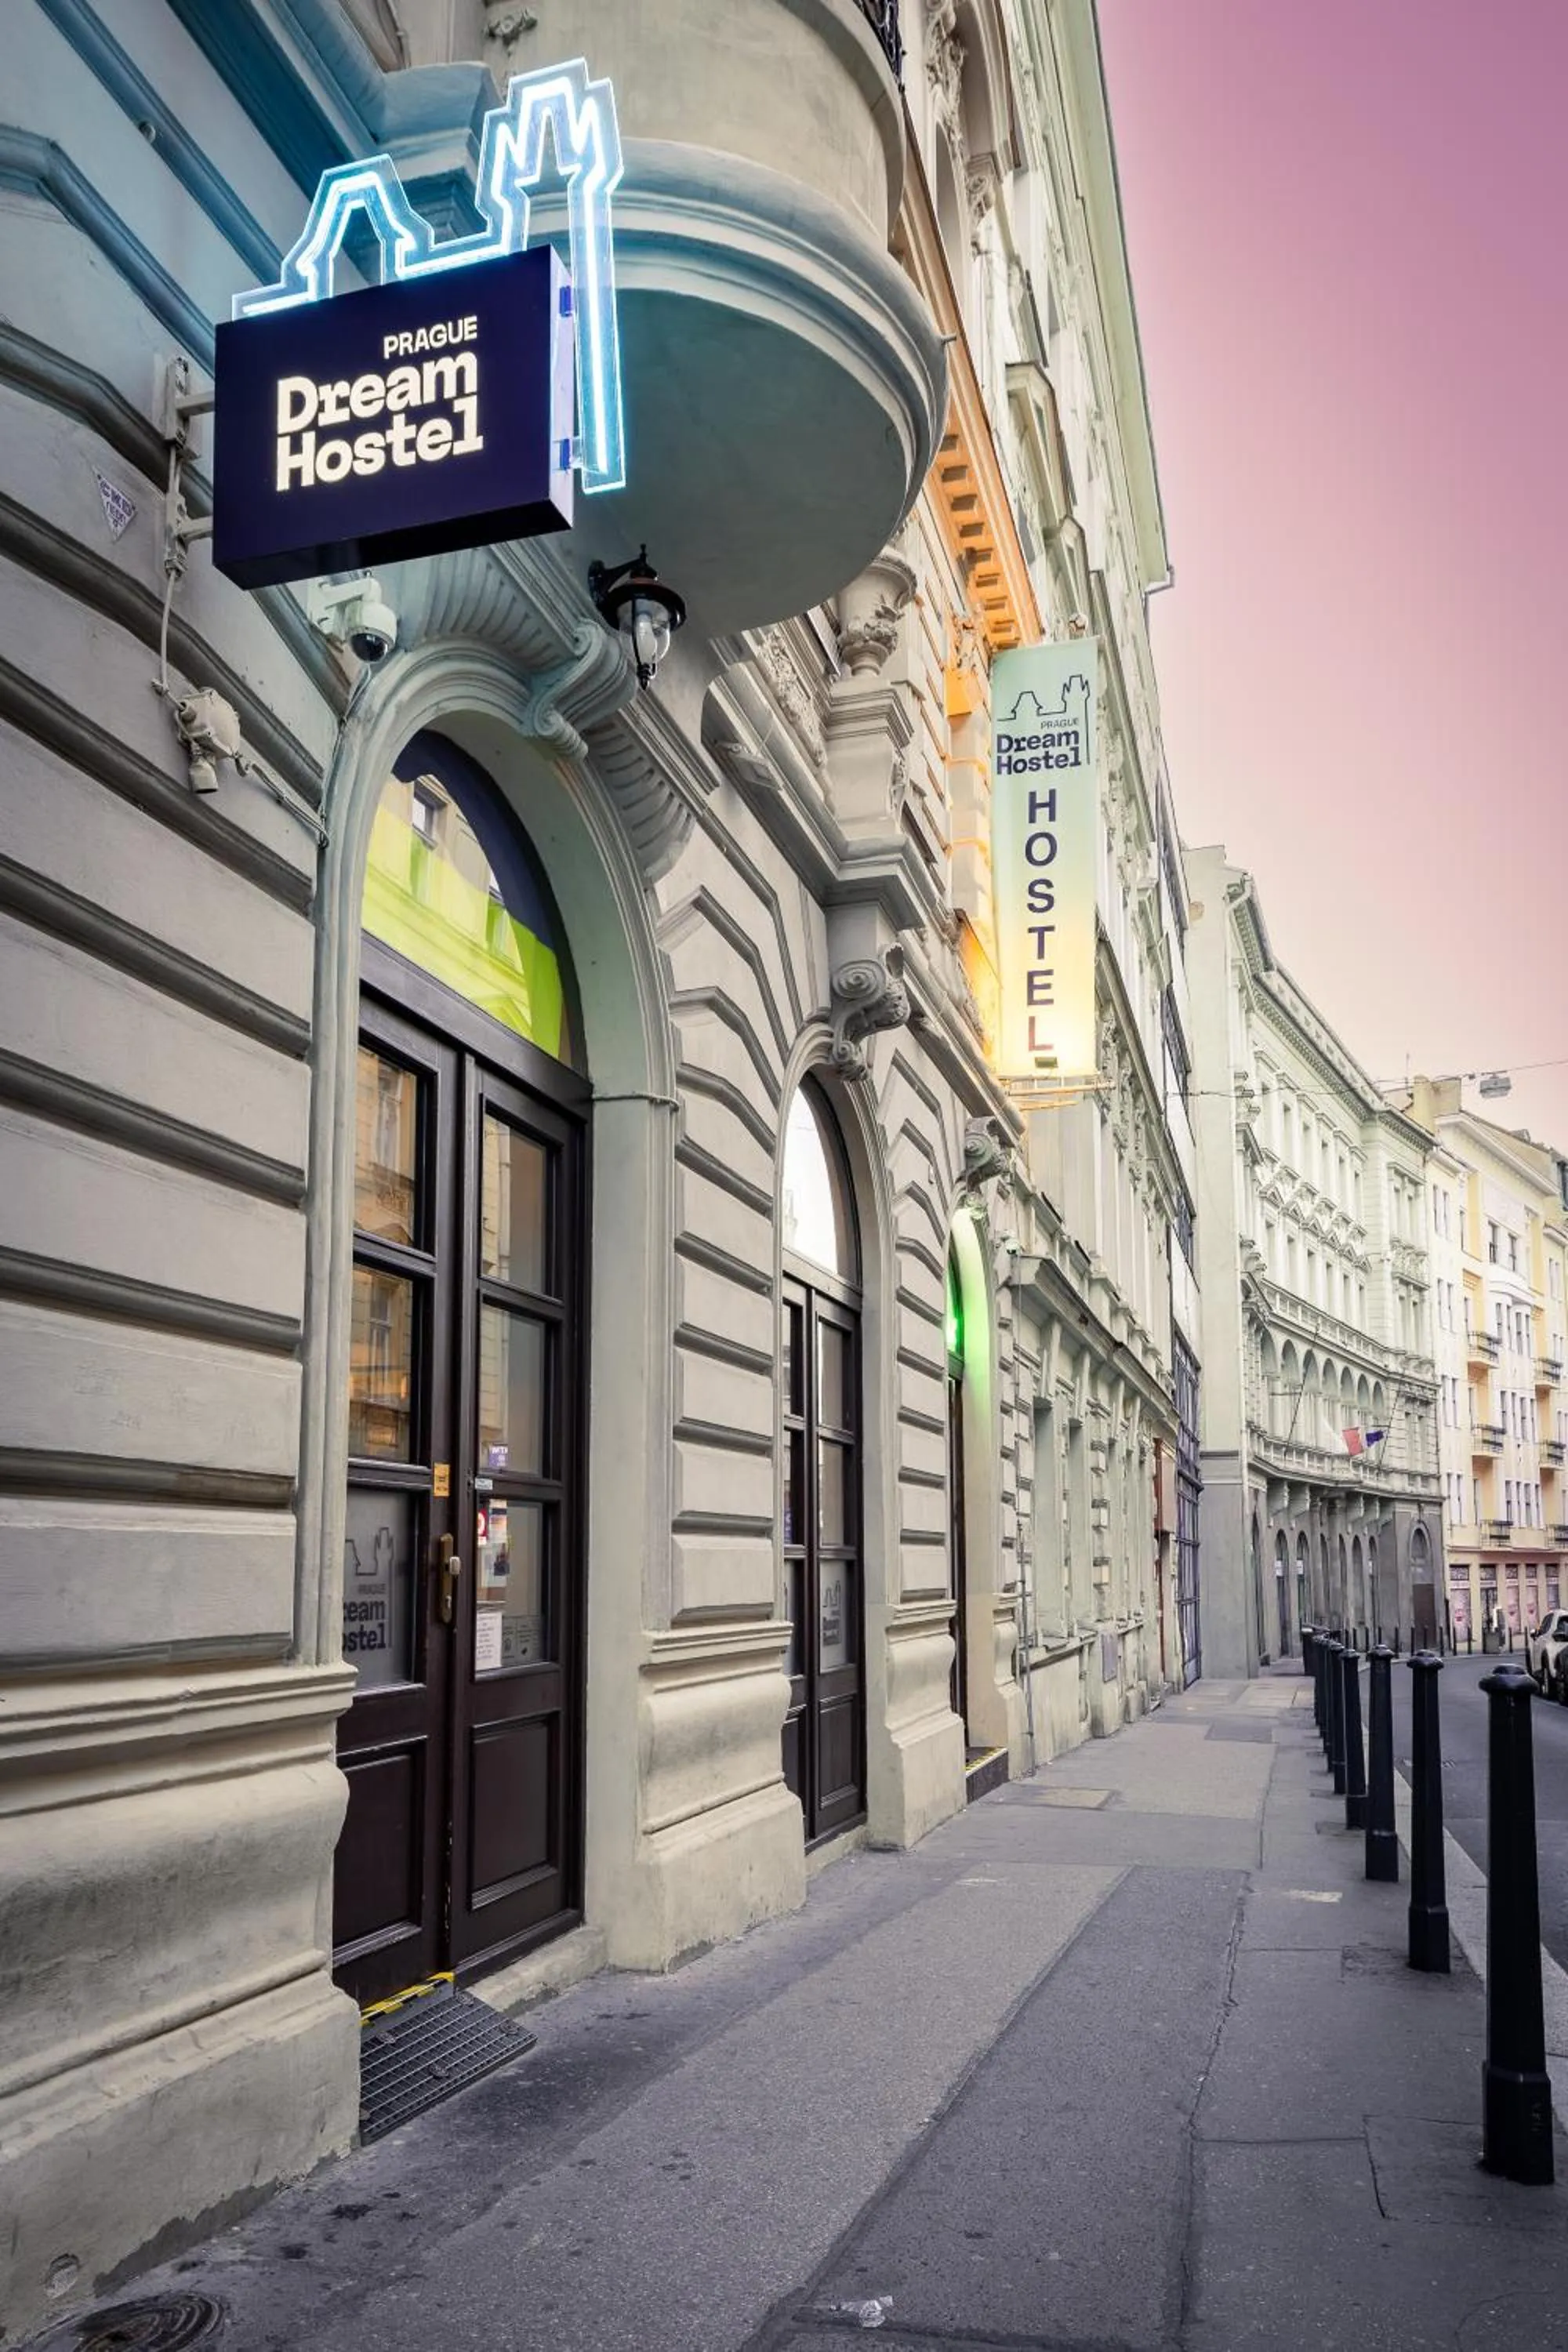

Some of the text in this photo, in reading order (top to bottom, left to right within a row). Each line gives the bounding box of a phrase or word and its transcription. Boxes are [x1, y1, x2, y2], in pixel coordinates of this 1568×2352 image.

[383, 315, 477, 360] PRAGUE
[277, 350, 478, 435] Dream
[276, 394, 484, 492] Hostel
[996, 730, 1080, 753] Dream
[1040, 717, 1080, 729] PRAGUE
[996, 746, 1082, 775] Hostel
[1024, 788, 1058, 1051] HOSTEL
